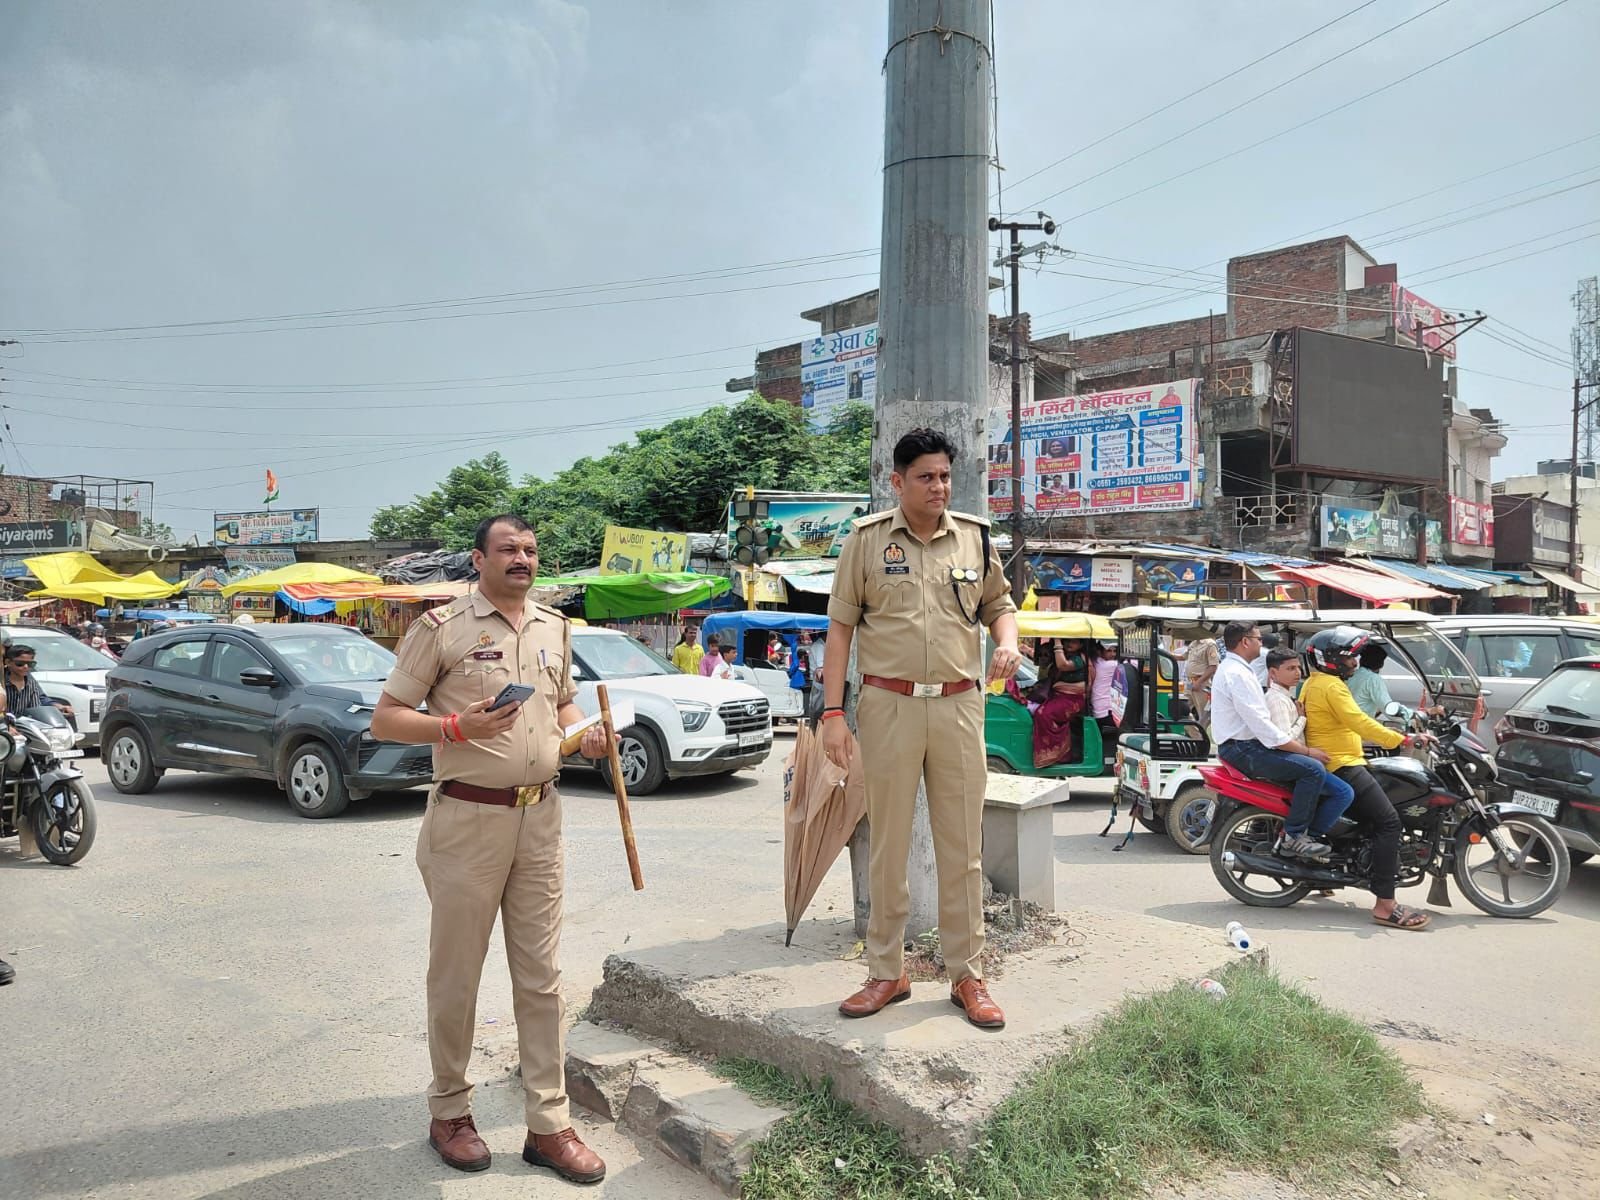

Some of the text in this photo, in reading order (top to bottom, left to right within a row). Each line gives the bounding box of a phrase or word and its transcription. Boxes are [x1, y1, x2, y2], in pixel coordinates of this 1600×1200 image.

[830, 332, 861, 354] सेवा
[1040, 398, 1075, 416] सिटी
[1079, 390, 1153, 411] हॉस्पिटल
[1050, 426, 1095, 437] VENTILATOR,
[1095, 423, 1120, 433] C-PAP
